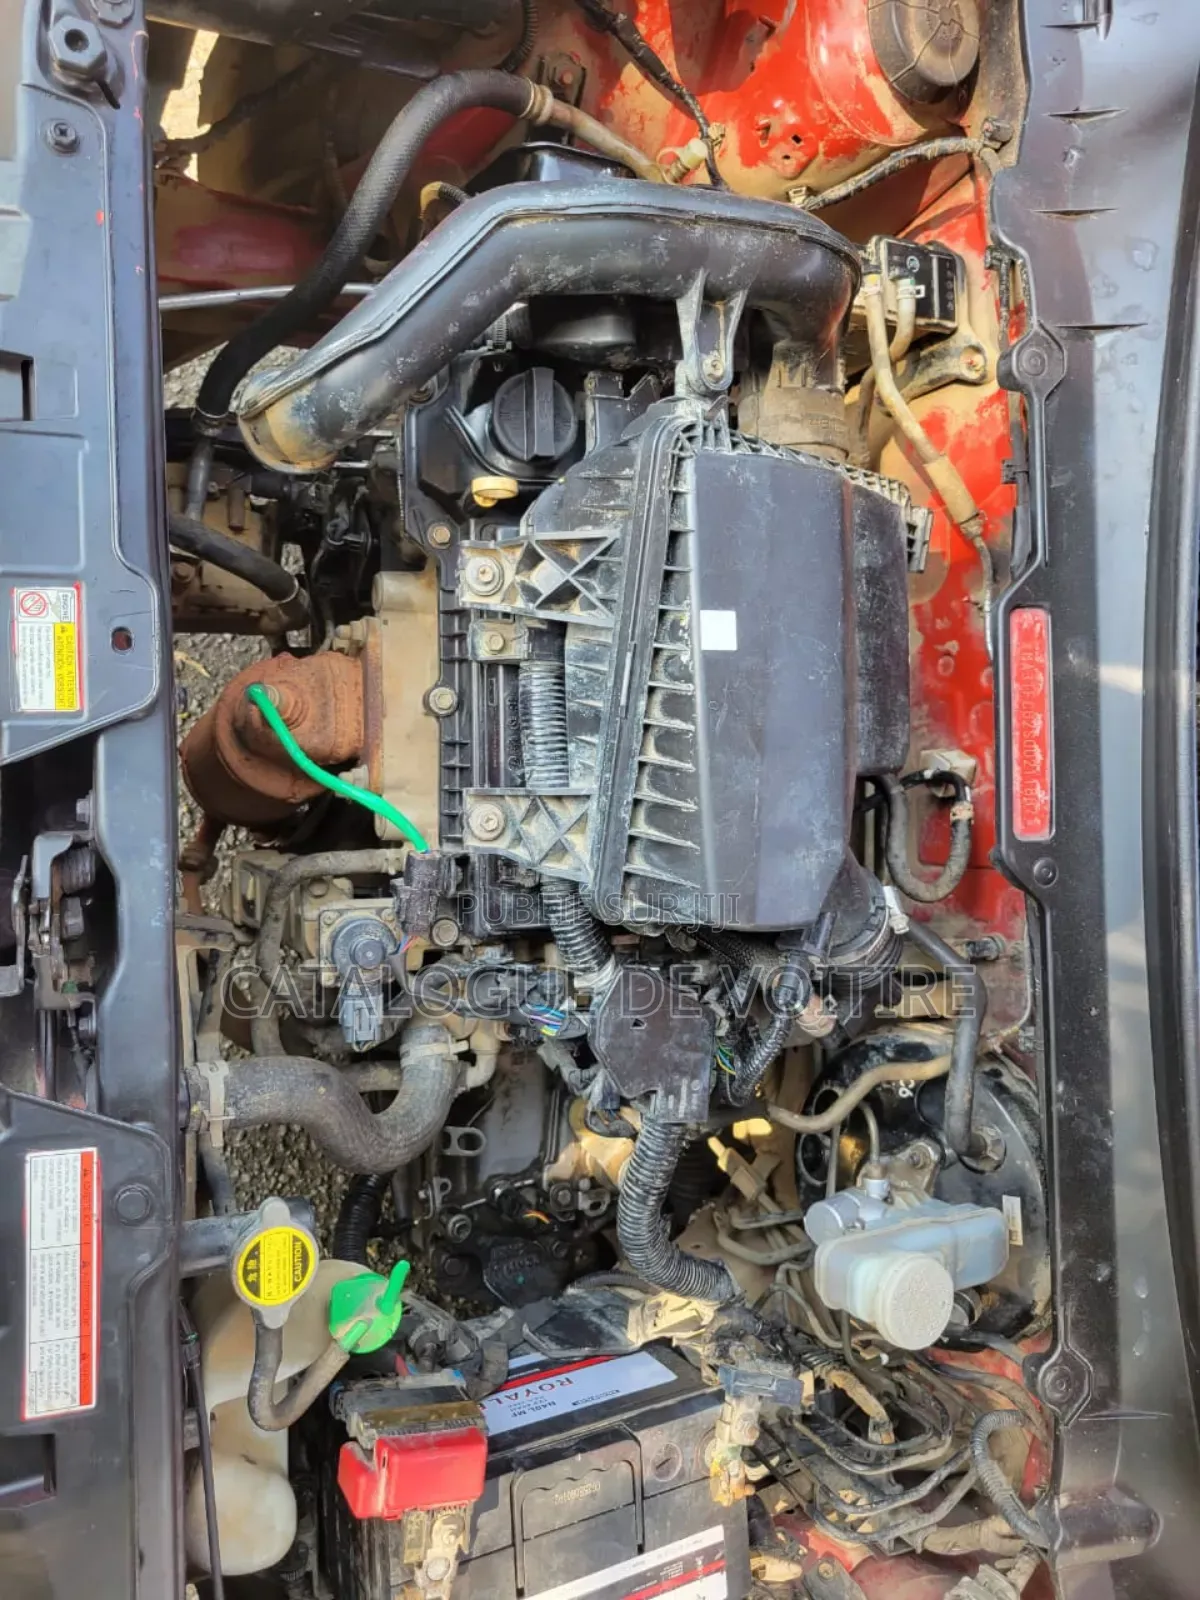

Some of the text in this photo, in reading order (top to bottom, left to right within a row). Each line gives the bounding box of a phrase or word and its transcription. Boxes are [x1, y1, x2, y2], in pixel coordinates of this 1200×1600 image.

[61, 593, 69, 621] ENGINE
[65, 635, 75, 708] CAUTION ATTENTION
[294, 1241, 303, 1282] CAUTION
